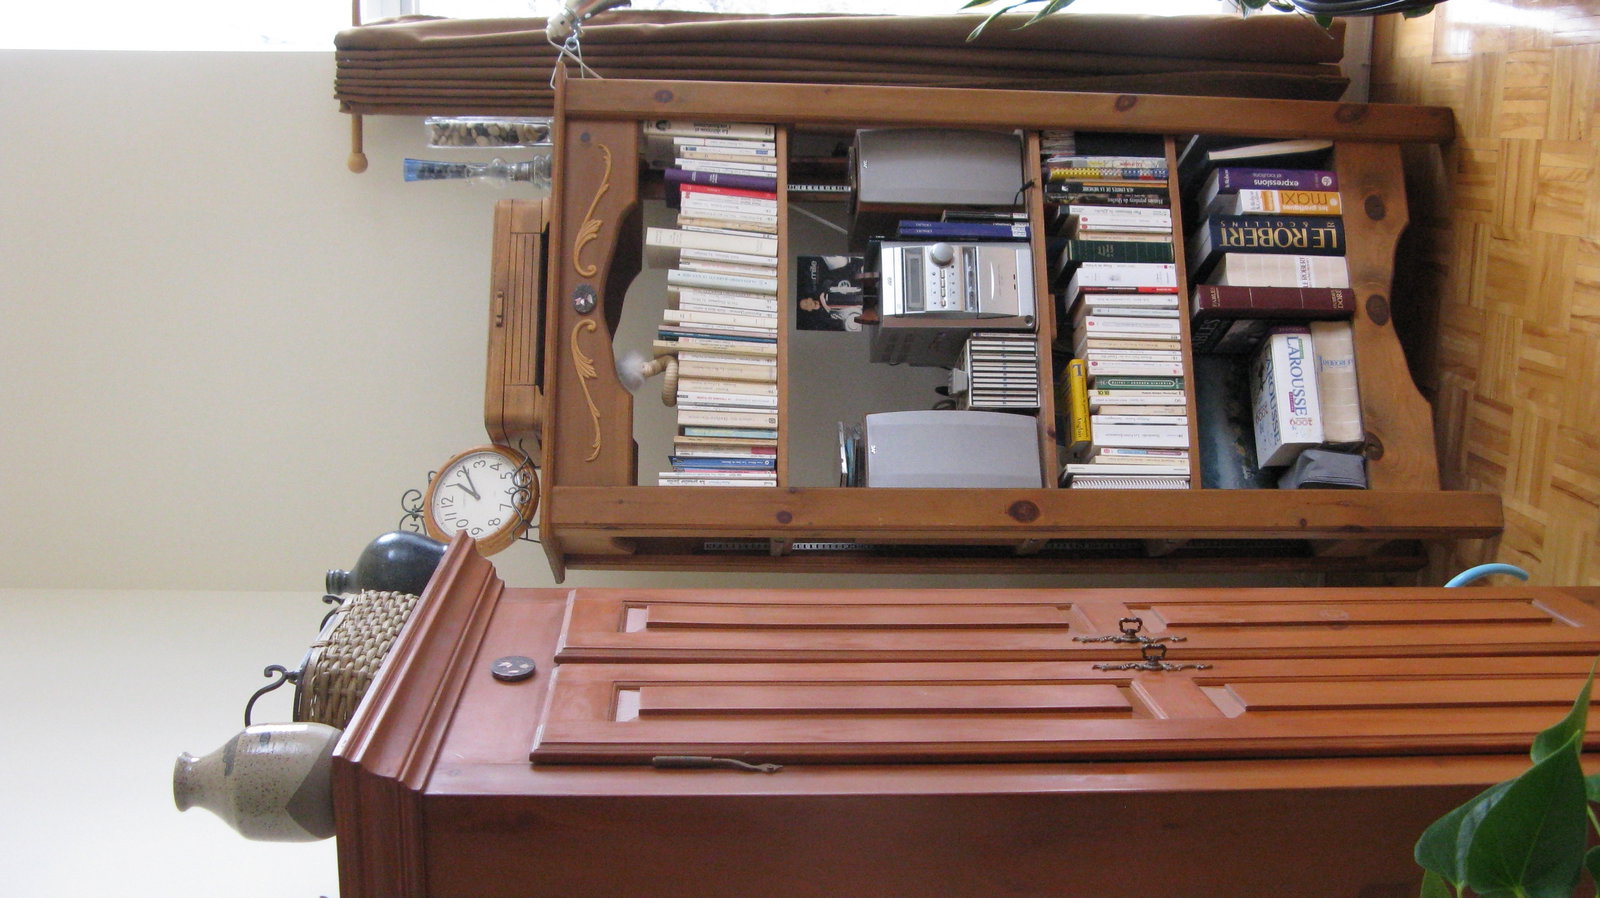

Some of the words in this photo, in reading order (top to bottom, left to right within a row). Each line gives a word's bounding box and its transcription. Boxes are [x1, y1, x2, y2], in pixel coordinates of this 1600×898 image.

[1253, 179, 1299, 187] expressions
[1280, 192, 1328, 205] maxi
[1219, 227, 1308, 248] ROBERT
[1312, 228, 1338, 248] LE
[1286, 336, 1308, 416] LAROUSSE
[473, 460, 486, 468] 3
[441, 496, 454, 508] 12
[444, 512, 457, 521] 11
[488, 518, 501, 527] 8
[471, 527, 484, 536] 9
